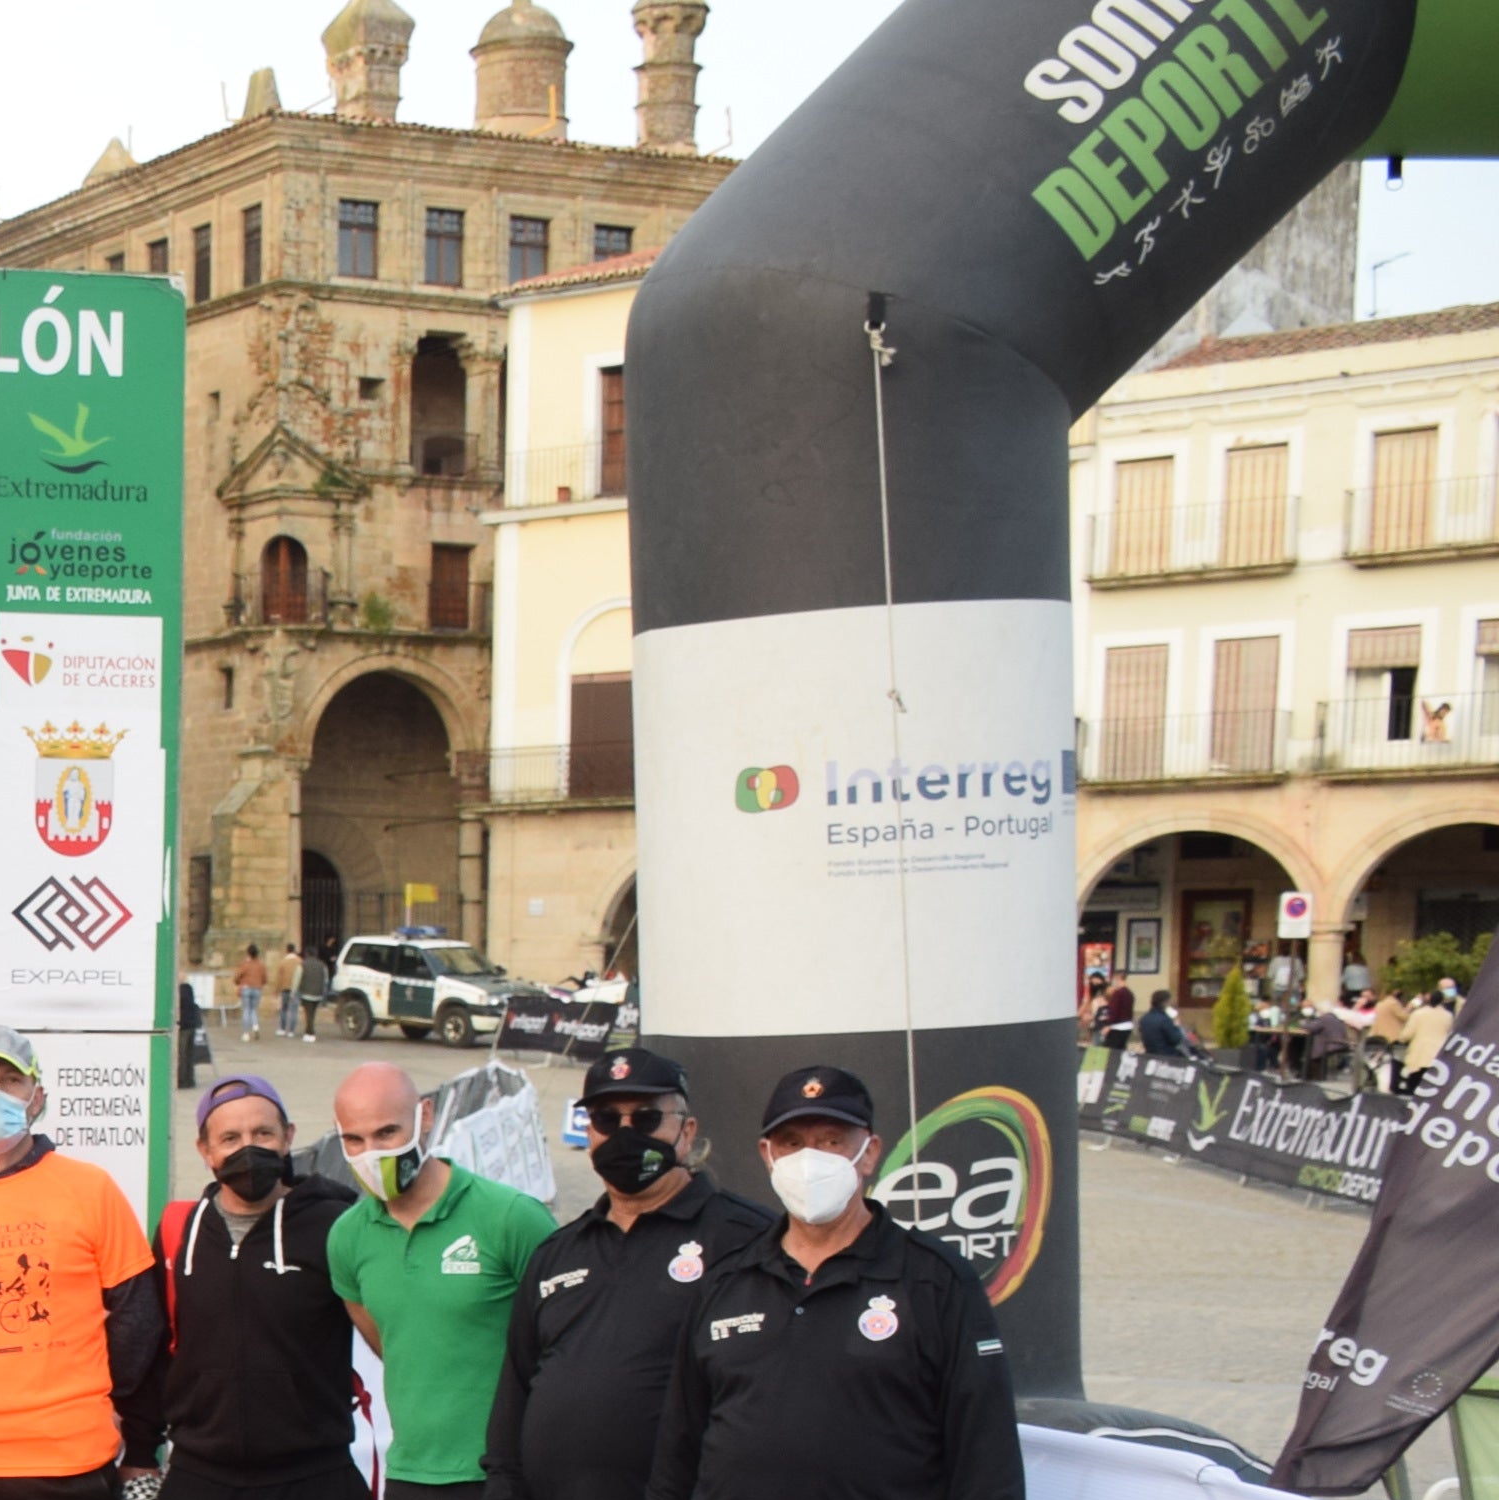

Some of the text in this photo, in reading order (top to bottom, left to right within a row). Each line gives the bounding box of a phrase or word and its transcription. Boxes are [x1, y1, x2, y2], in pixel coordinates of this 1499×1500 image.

[1024, 0, 1204, 124] SOM
[50, 528, 122, 542] fundación
[8, 531, 126, 565] jóvenes
[6, 585, 152, 604] JUNTA DE EXTREMADURA
[63, 653, 156, 670] DIPUTACIÓN
[63, 673, 81, 686] DE
[824, 757, 1053, 806] Interreg
[826, 818, 935, 848] España
[964, 811, 1053, 840] Portugal
[11, 969, 132, 986] EXPAPEL
[57, 1064, 145, 1087] FEDERACIÓN
[60, 1095, 142, 1117] EXTREMEÑA
[1228, 1078, 1398, 1171] Extremadur
[56, 1127, 74, 1146] DE
